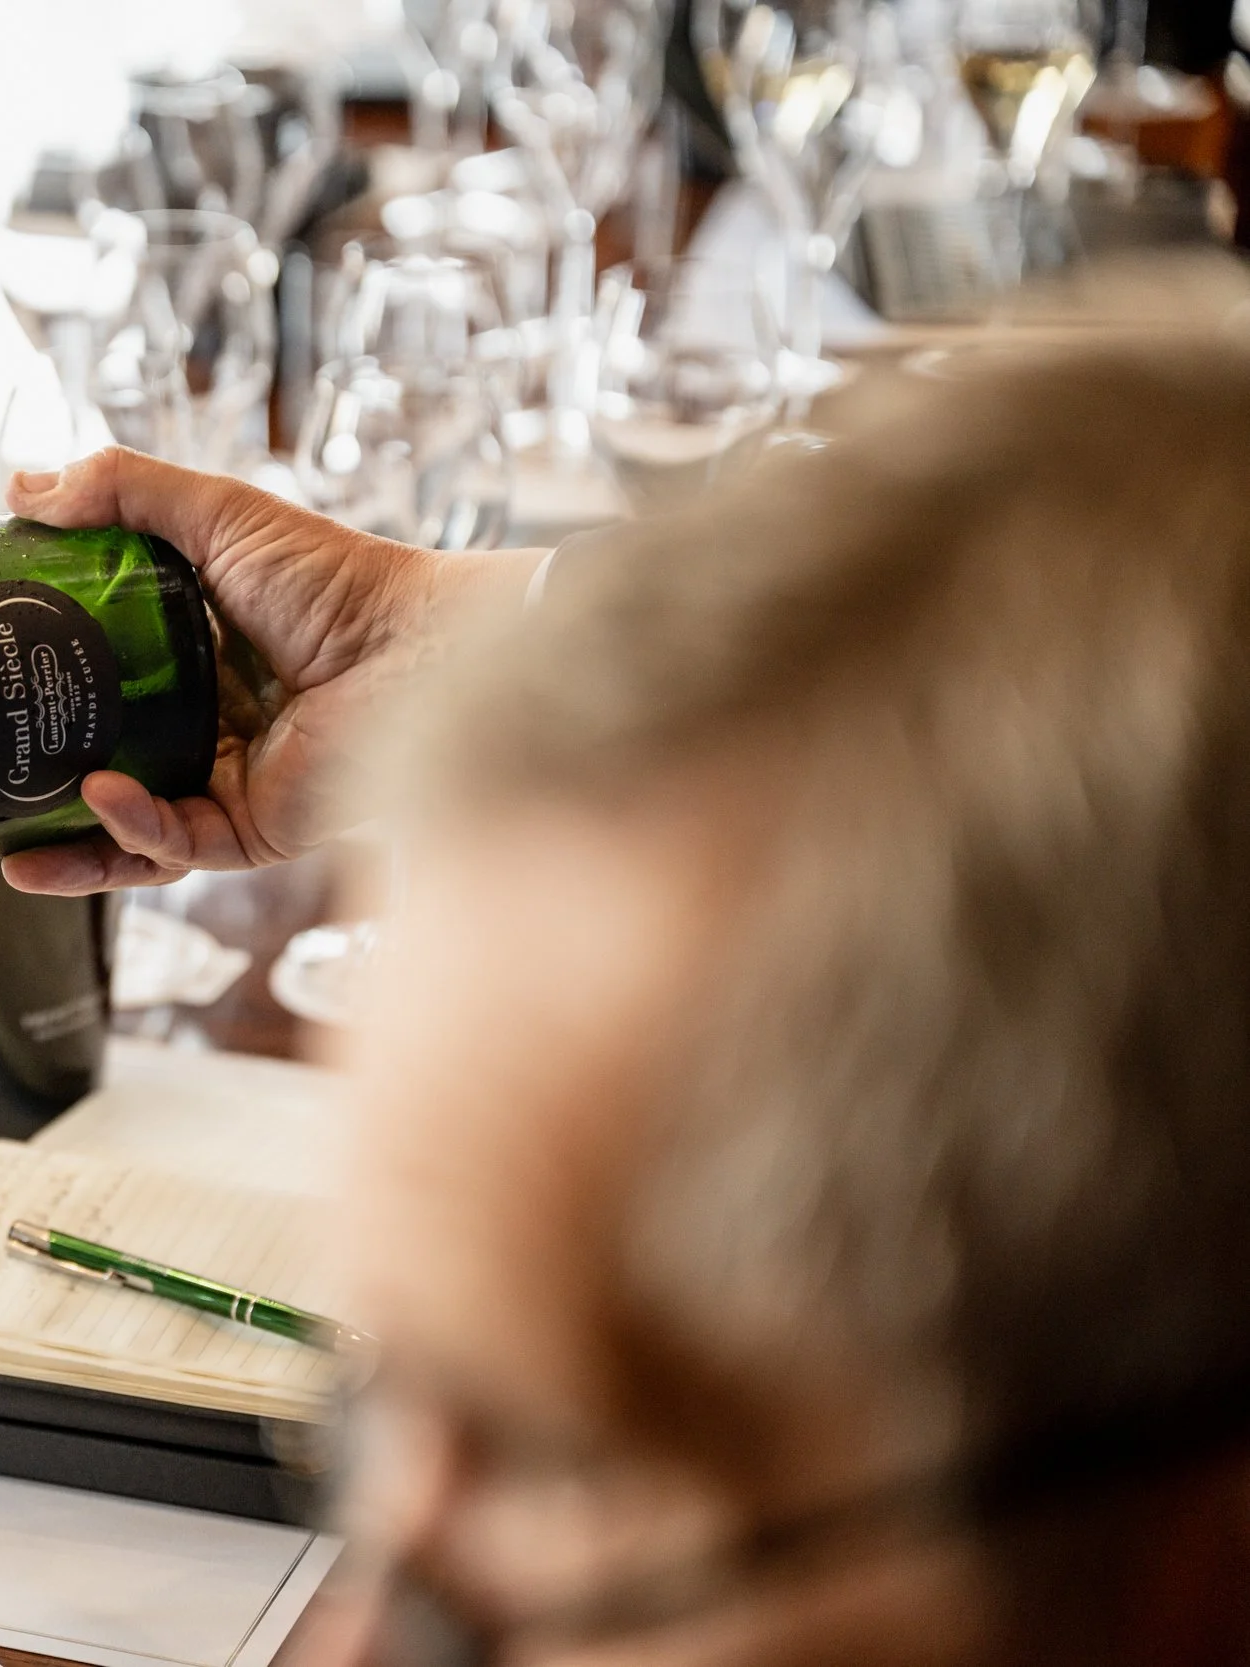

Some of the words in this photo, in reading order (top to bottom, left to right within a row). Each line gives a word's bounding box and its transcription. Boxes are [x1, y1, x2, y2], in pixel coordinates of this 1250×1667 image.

[70, 638, 94, 684] CUVÉE
[40, 650, 59, 750] Laurent-Perrier
[74, 684, 82, 707] 1812
[83, 691, 97, 749] GRANDE
[6, 708, 31, 785] Grand
